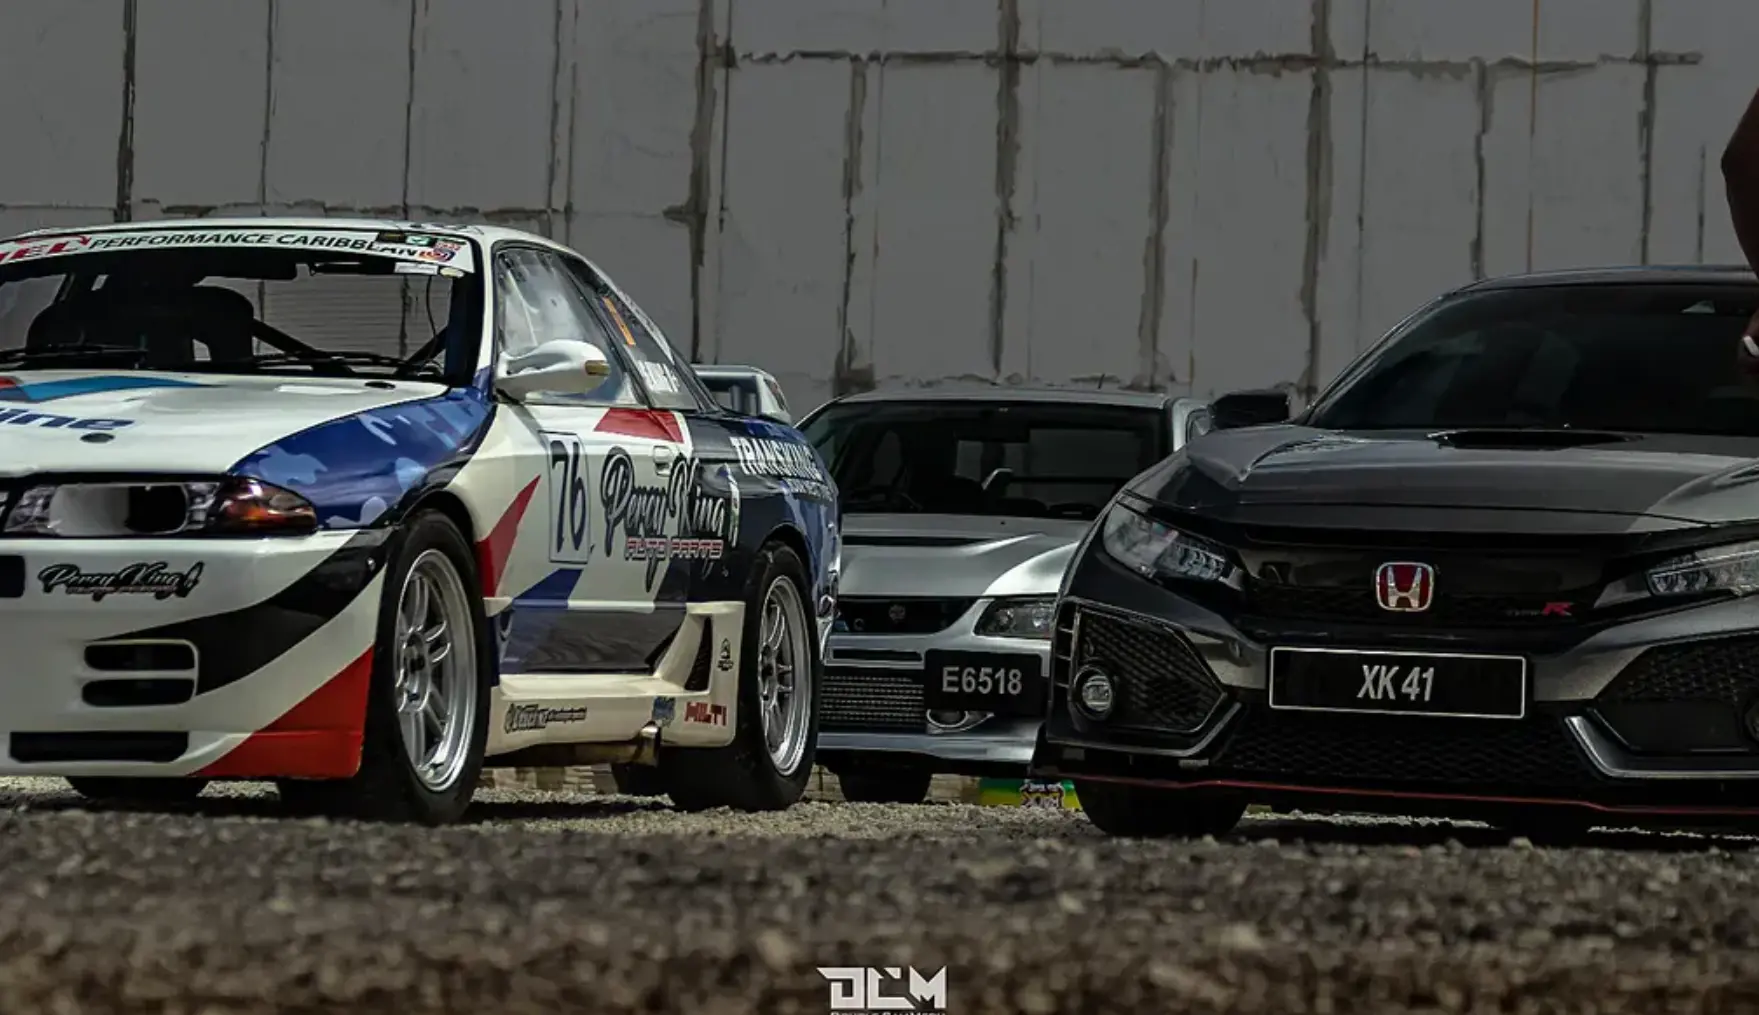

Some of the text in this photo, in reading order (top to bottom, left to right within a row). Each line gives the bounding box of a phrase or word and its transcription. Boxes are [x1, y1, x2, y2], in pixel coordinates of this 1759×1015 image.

[89, 232, 273, 250] PERFORMANCE
[0, 407, 135, 429] ine
[549, 440, 588, 553] 76
[669, 454, 726, 580] King
[942, 665, 1023, 695] E6518
[1356, 664, 1436, 702] XK 41
